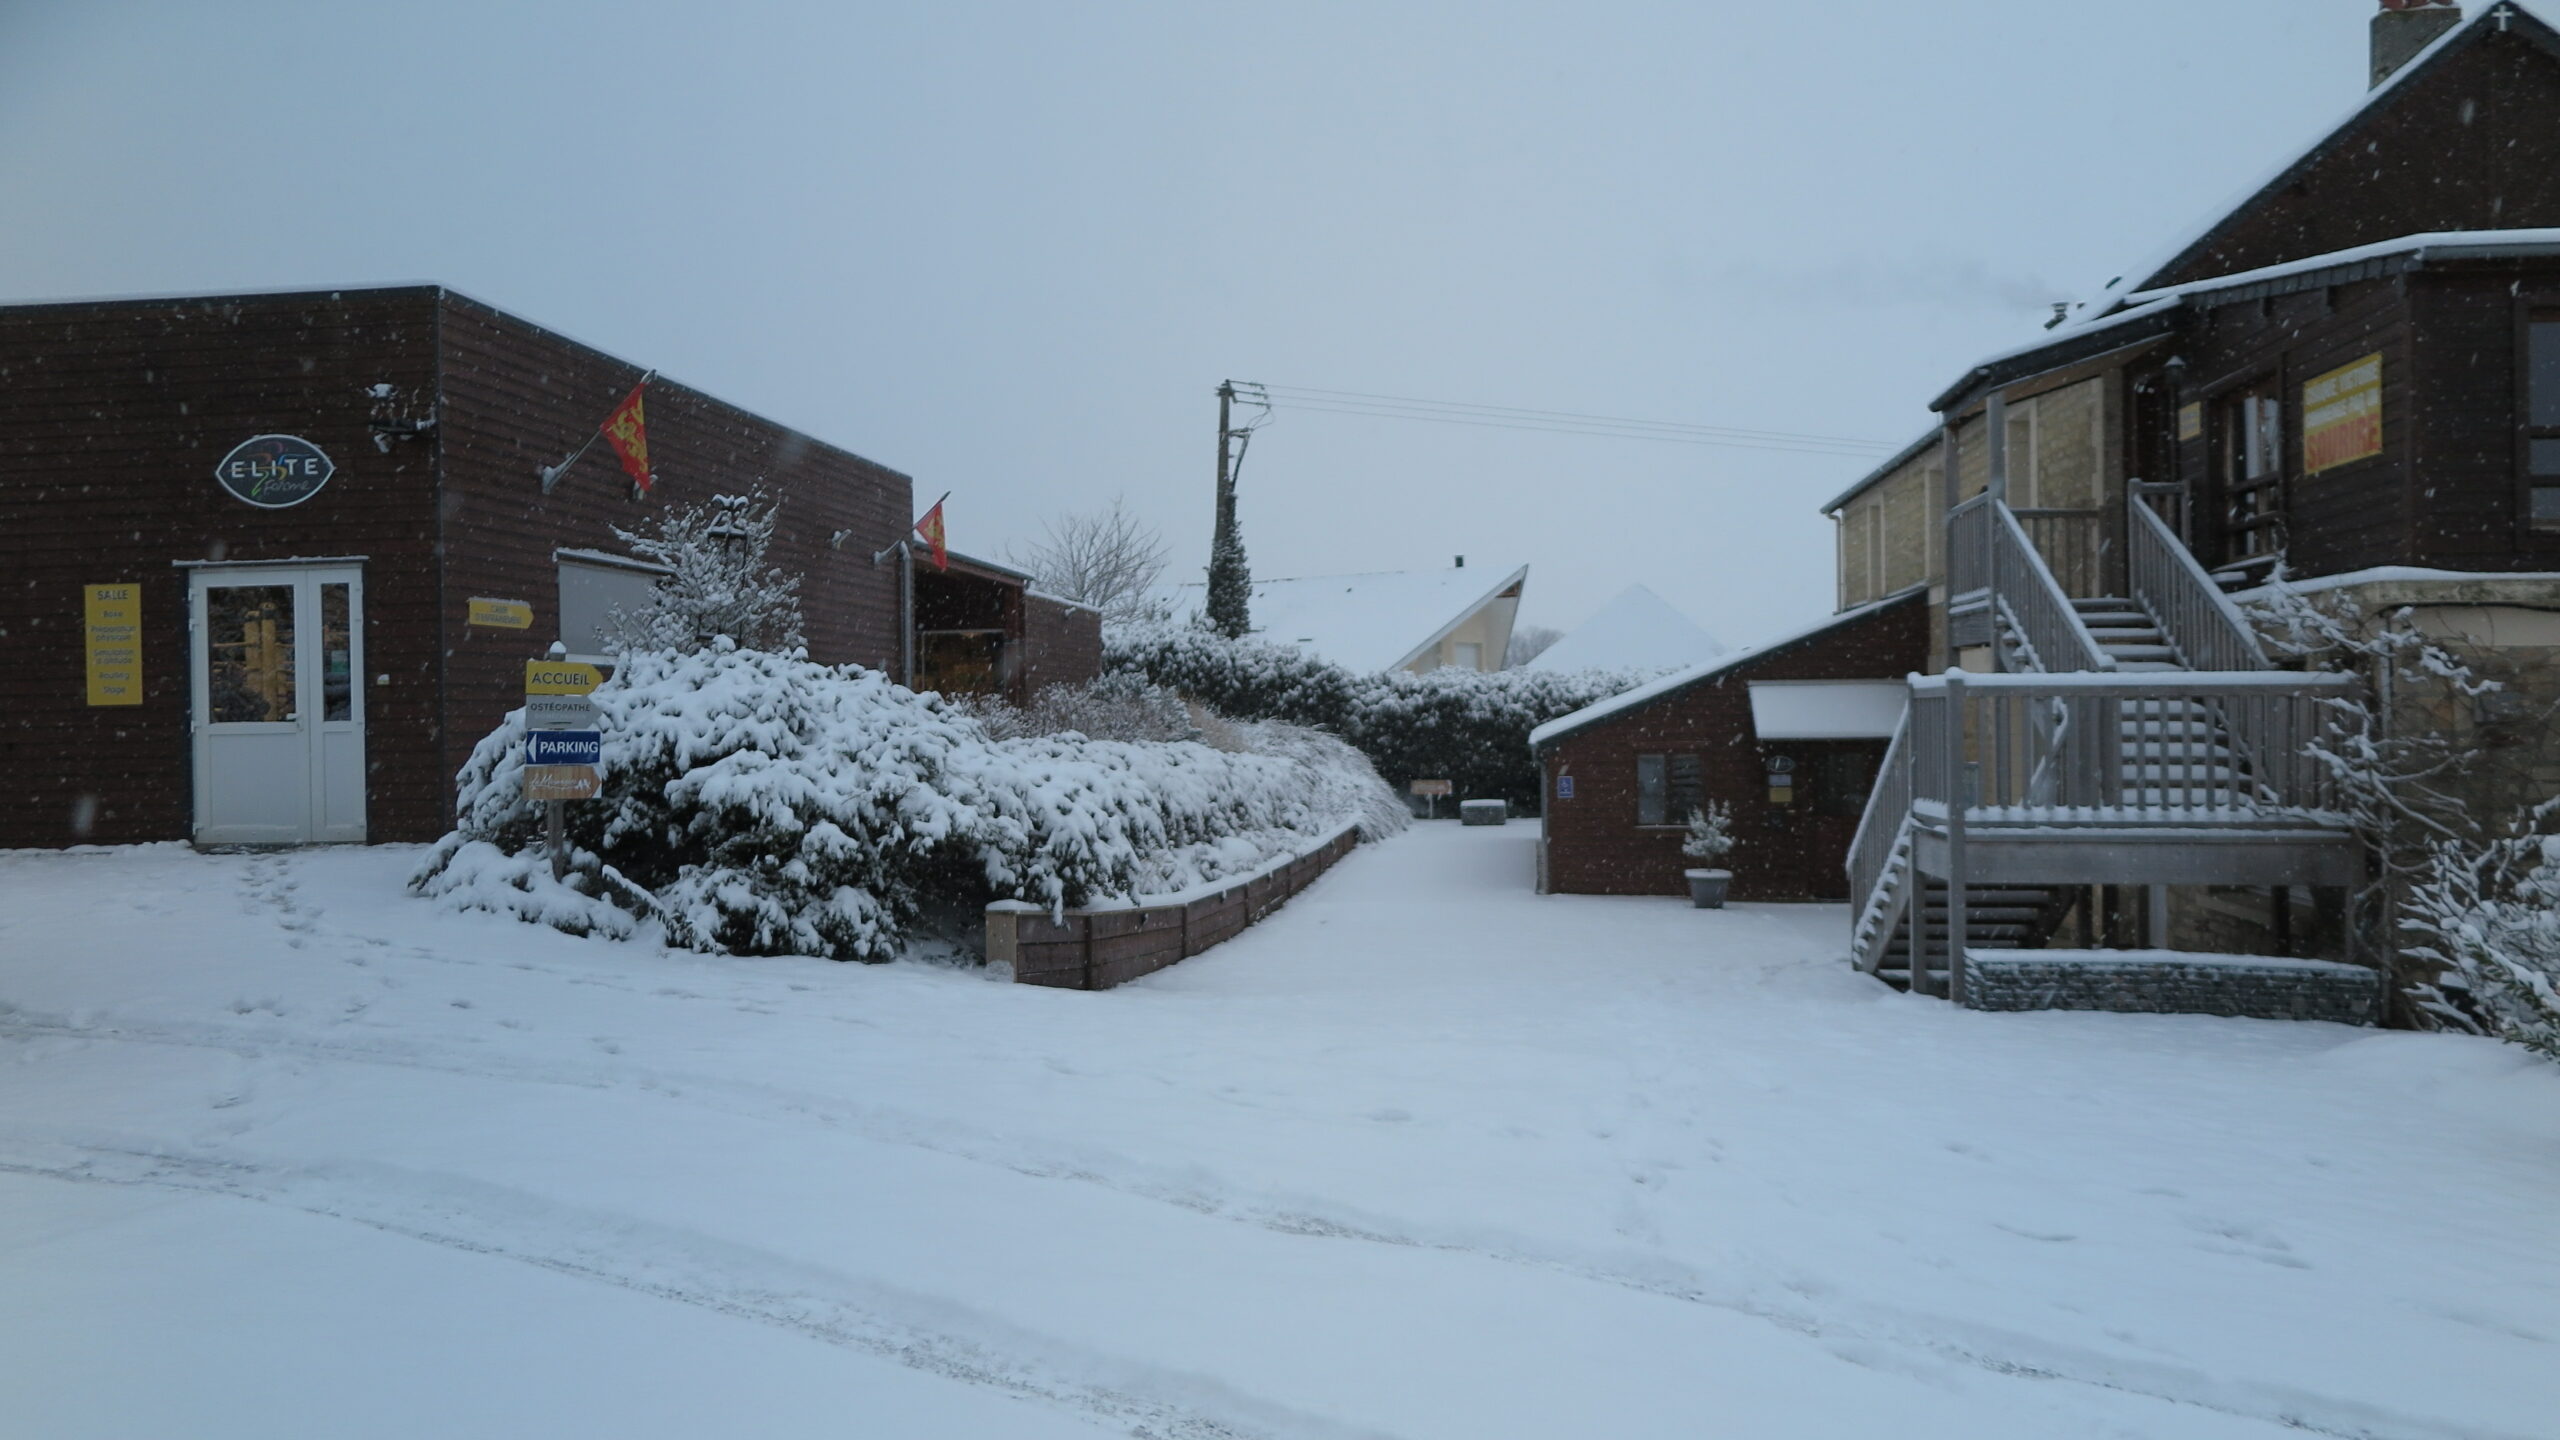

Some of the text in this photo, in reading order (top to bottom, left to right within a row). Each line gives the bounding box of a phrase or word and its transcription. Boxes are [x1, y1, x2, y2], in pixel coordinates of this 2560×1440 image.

[2307, 413, 2378, 469] SOURIRE
[231, 458, 319, 478] ELITE
[97, 589, 128, 601] SALLE
[530, 702, 591, 712] OSTÉOPATHE
[540, 741, 599, 754] PARKING
